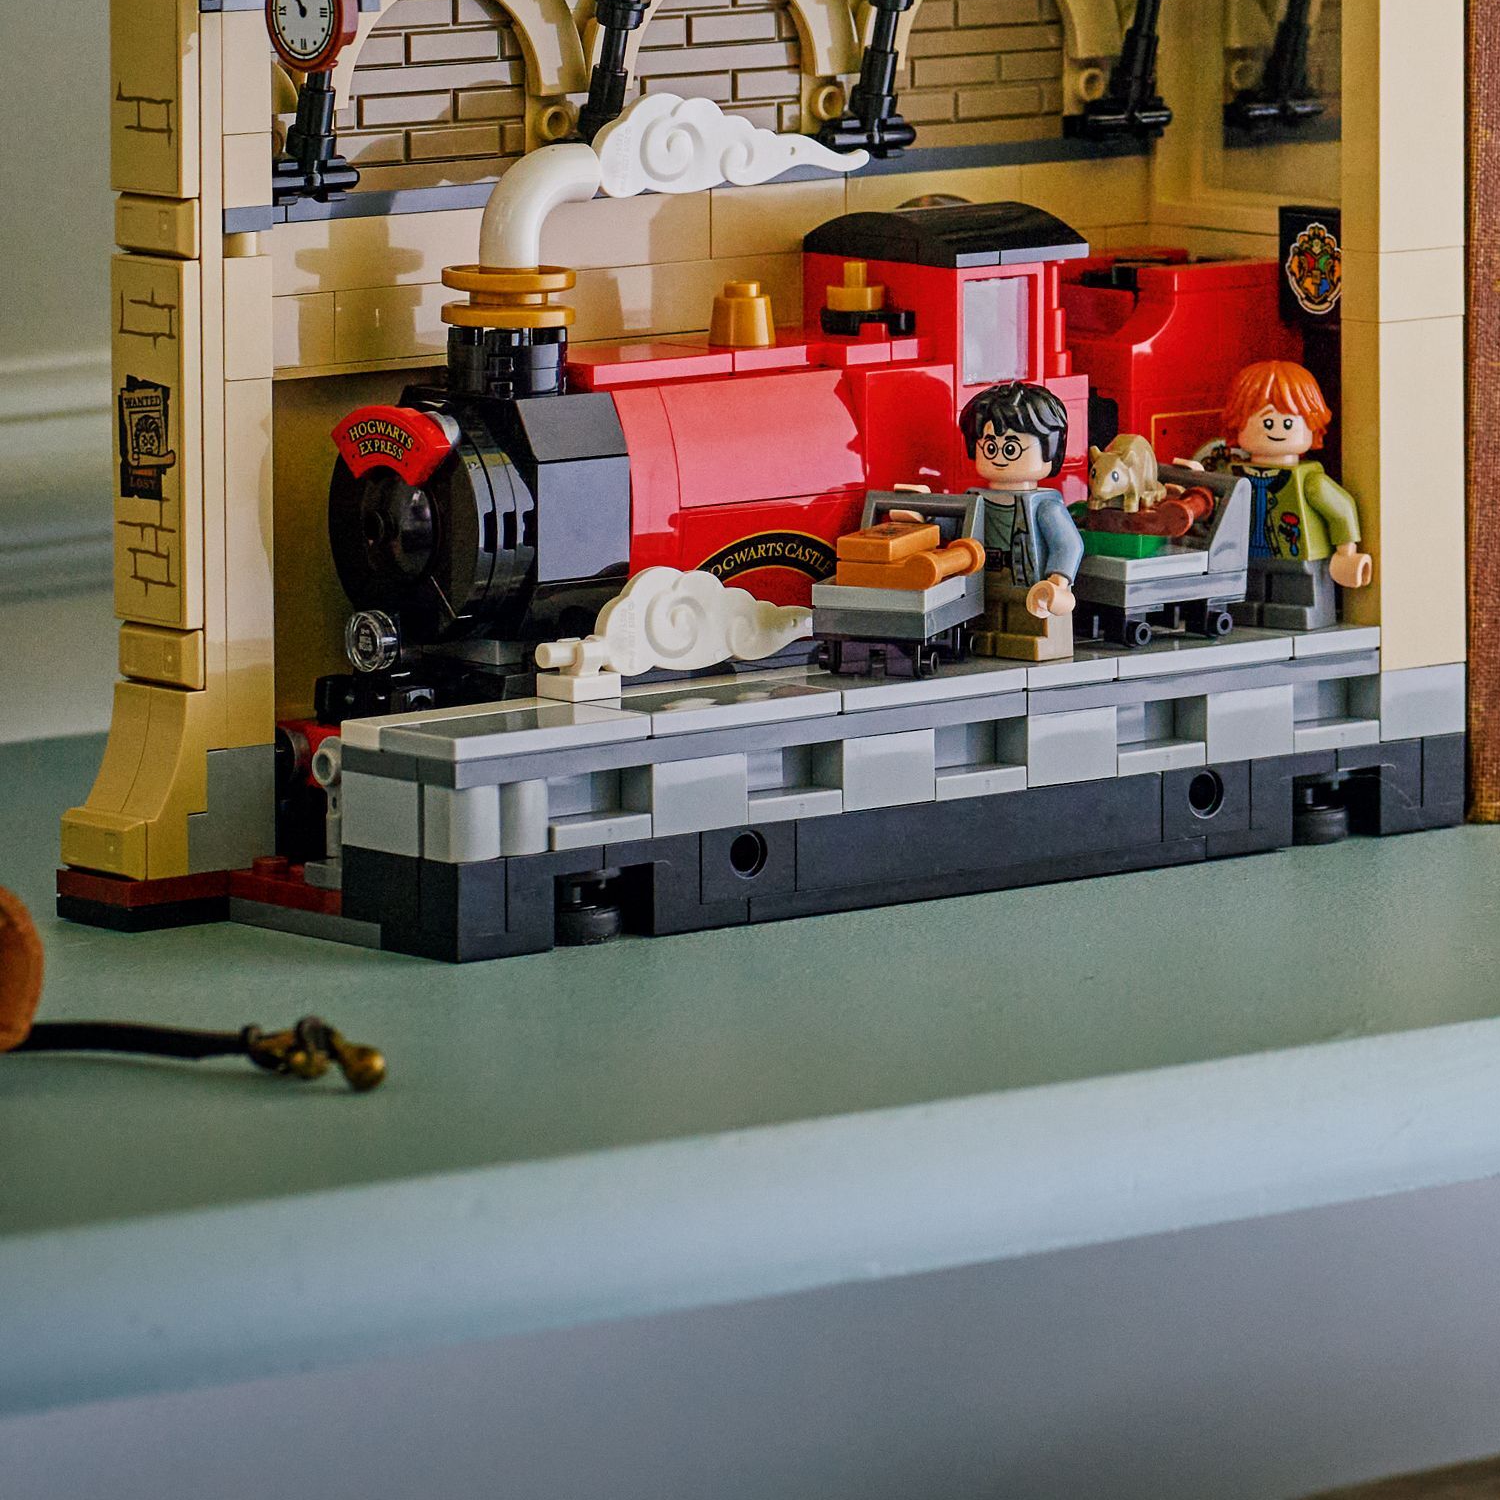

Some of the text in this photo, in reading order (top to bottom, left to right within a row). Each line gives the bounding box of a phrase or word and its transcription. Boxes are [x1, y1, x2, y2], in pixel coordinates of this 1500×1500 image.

[124, 395, 161, 408] WANTED
[348, 420, 414, 450] HOGWARTS
[358, 439, 404, 460] EXPRESS
[710, 542, 833, 577] OGWARTS CASTLE
